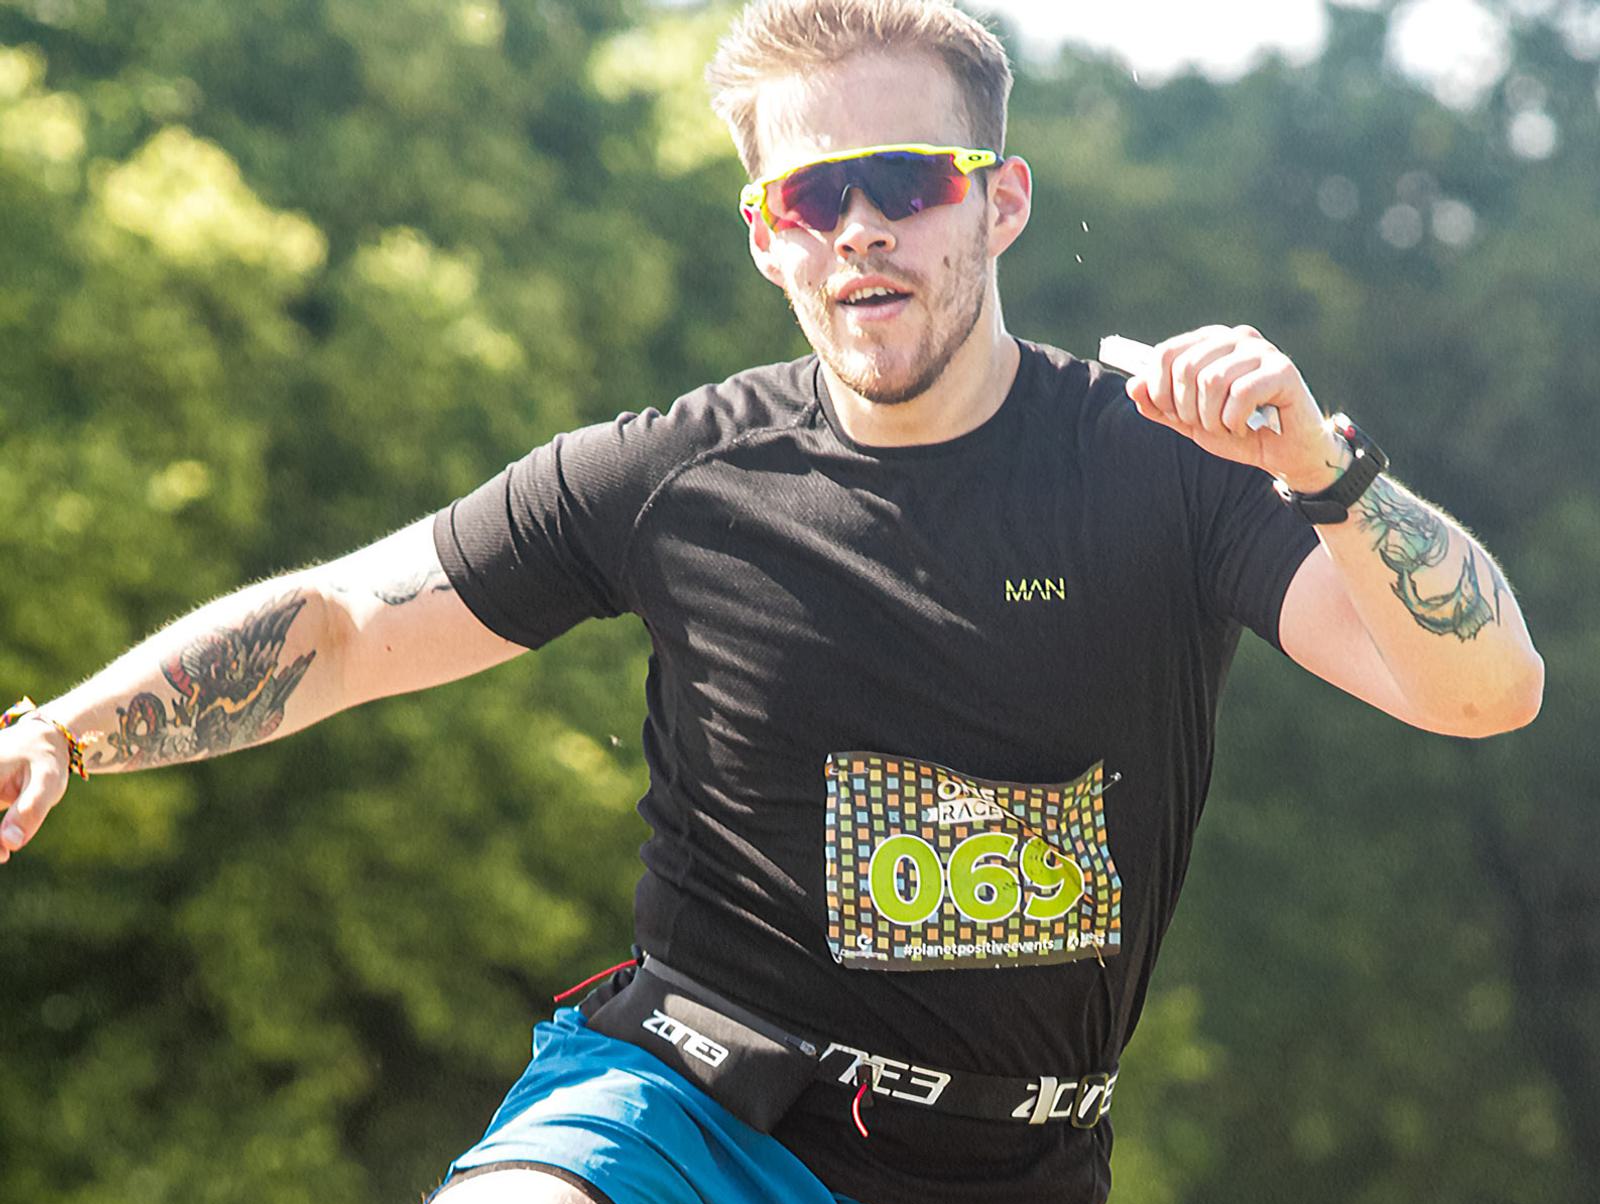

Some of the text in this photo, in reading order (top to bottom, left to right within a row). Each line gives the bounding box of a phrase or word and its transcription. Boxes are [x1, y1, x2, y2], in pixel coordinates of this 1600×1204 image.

[1005, 577, 1065, 602] MAN
[942, 800, 1001, 820] RACE
[868, 832, 1084, 925] 069
[903, 938, 1054, 960] #planetpositiveevents
[641, 1008, 730, 1068] ZONE3
